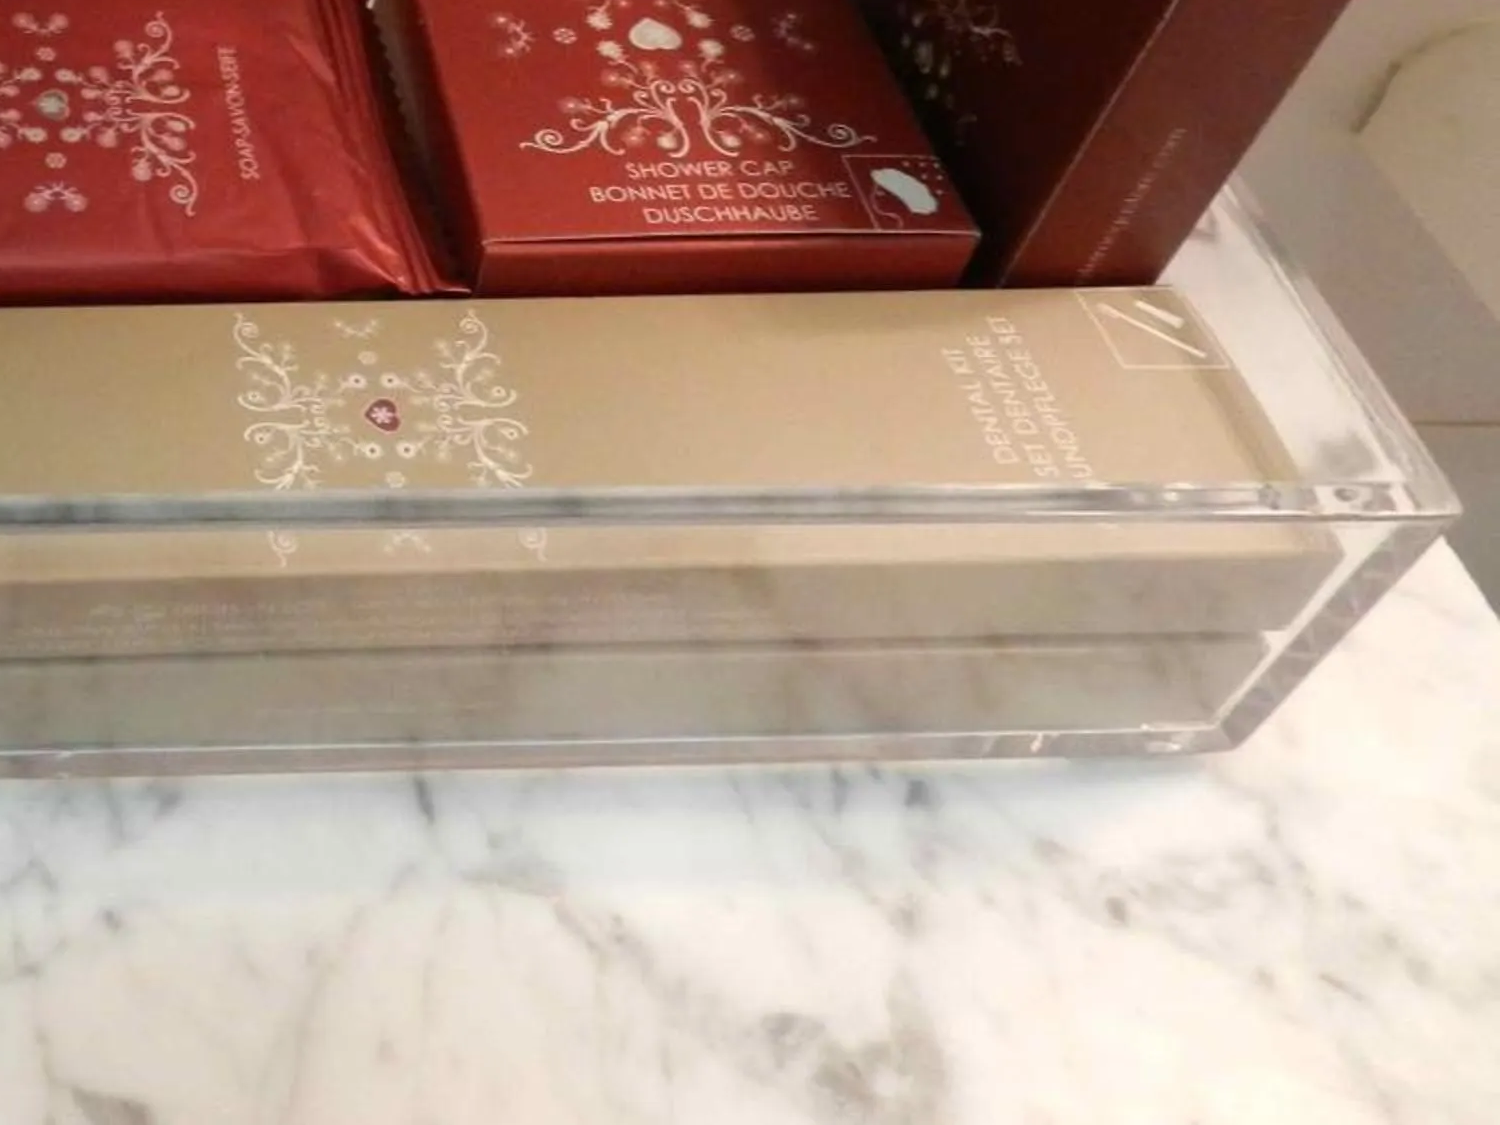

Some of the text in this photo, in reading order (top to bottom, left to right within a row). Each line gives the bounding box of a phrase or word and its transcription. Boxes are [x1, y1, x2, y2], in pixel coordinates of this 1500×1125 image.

[588, 180, 854, 204] BONNET DE DOUCHE
[624, 159, 796, 180] SHOWER CAP
[642, 204, 821, 225] DUSCHHAUBE
[941, 346, 1020, 465] DENTAL KIT
[965, 332, 1061, 477] SET DENTAIRE
[986, 314, 1094, 479] UNDPFLEGE SET
